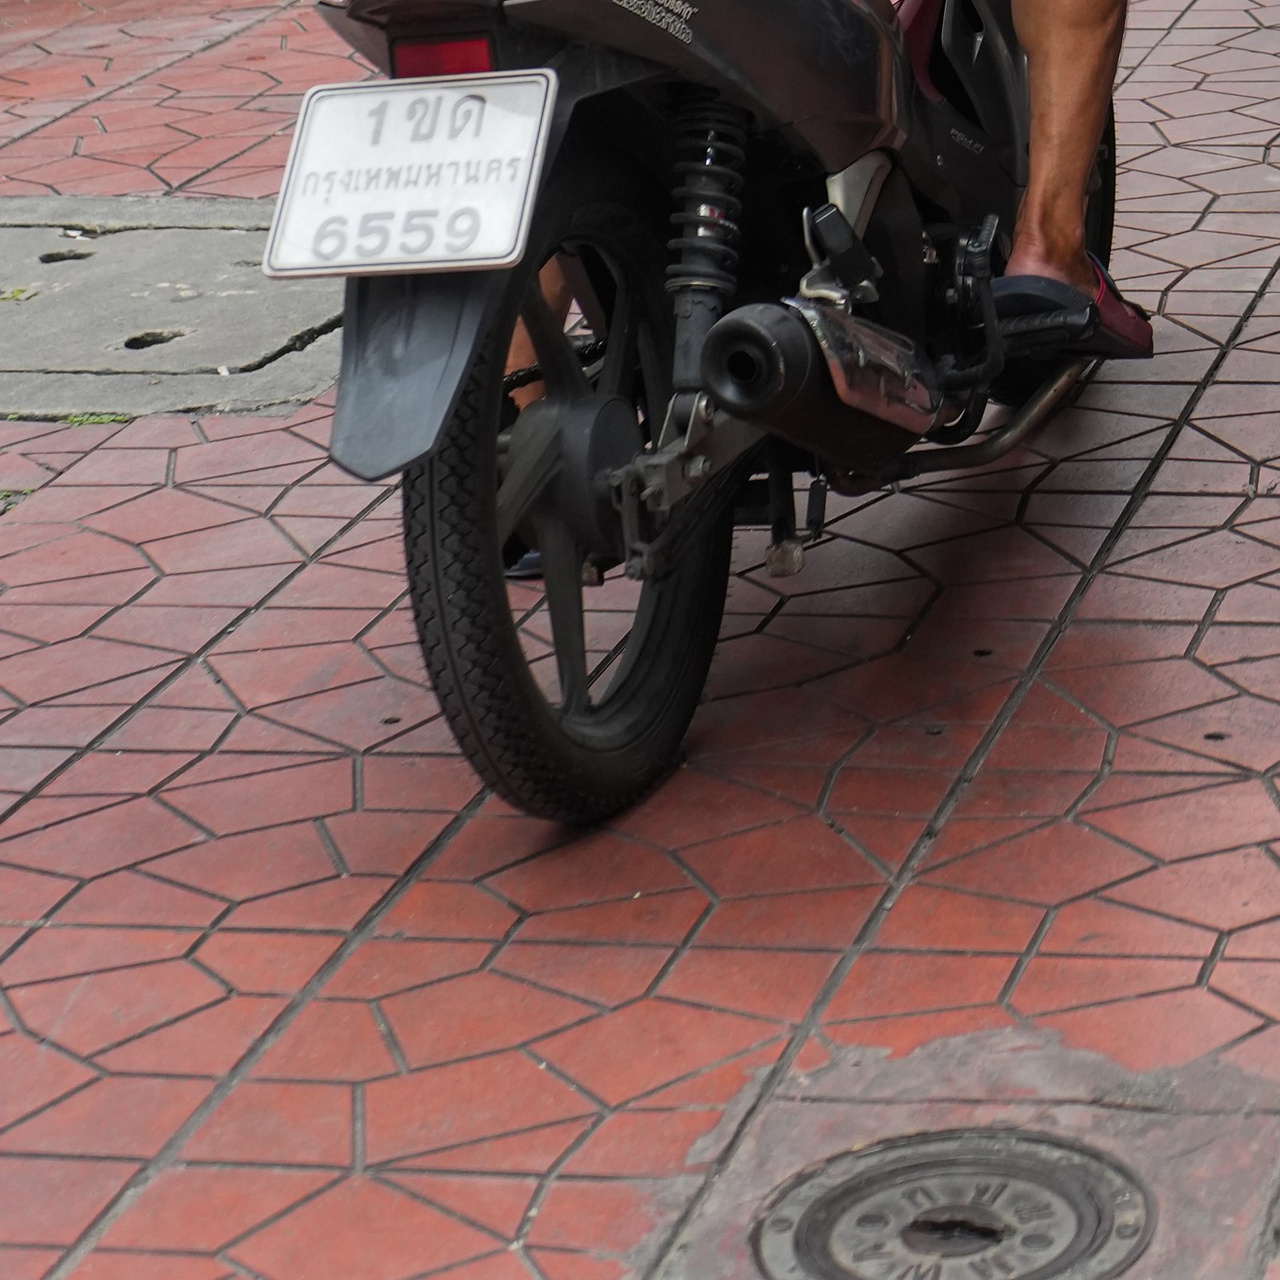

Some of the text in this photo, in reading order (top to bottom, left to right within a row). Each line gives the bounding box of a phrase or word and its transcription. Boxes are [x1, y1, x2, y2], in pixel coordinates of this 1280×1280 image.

[369, 94, 487, 146] 1ขด
[302, 156, 522, 204] กรุงเทพมหานคร
[311, 206, 482, 261] 6559
